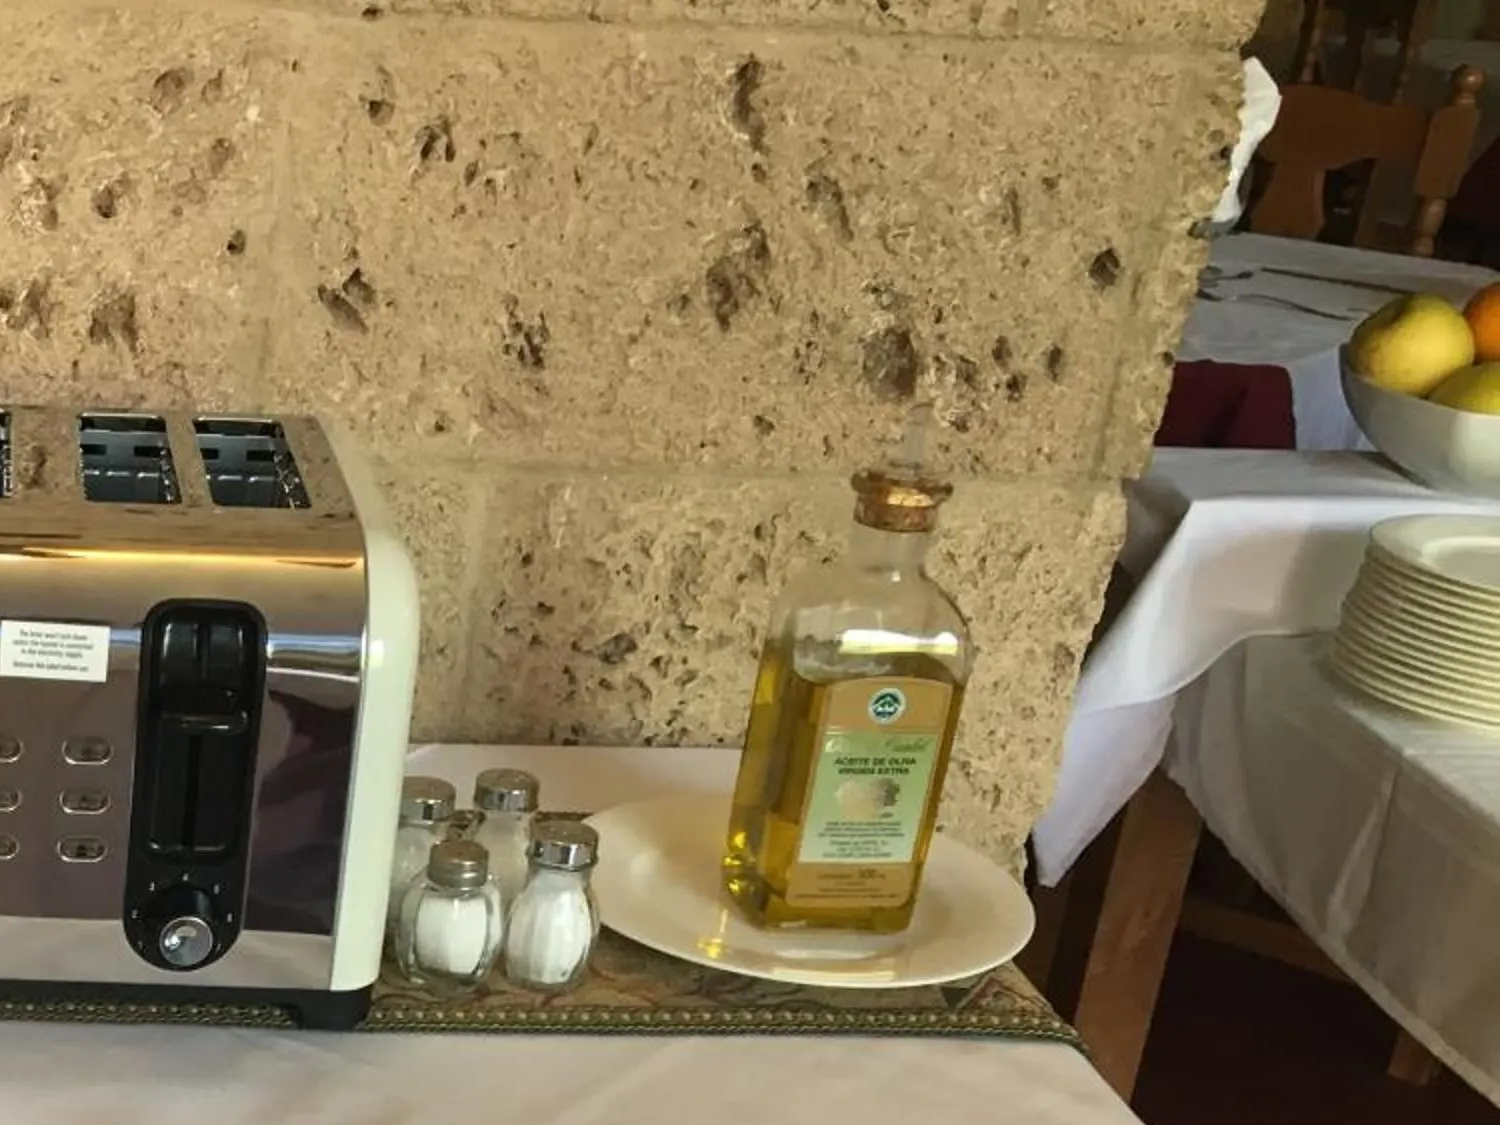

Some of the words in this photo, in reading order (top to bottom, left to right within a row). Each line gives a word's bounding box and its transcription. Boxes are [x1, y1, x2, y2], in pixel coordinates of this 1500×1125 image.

[834, 757, 870, 766] ACEITE
[872, 757, 885, 766] DE
[888, 757, 917, 766] OLIVA
